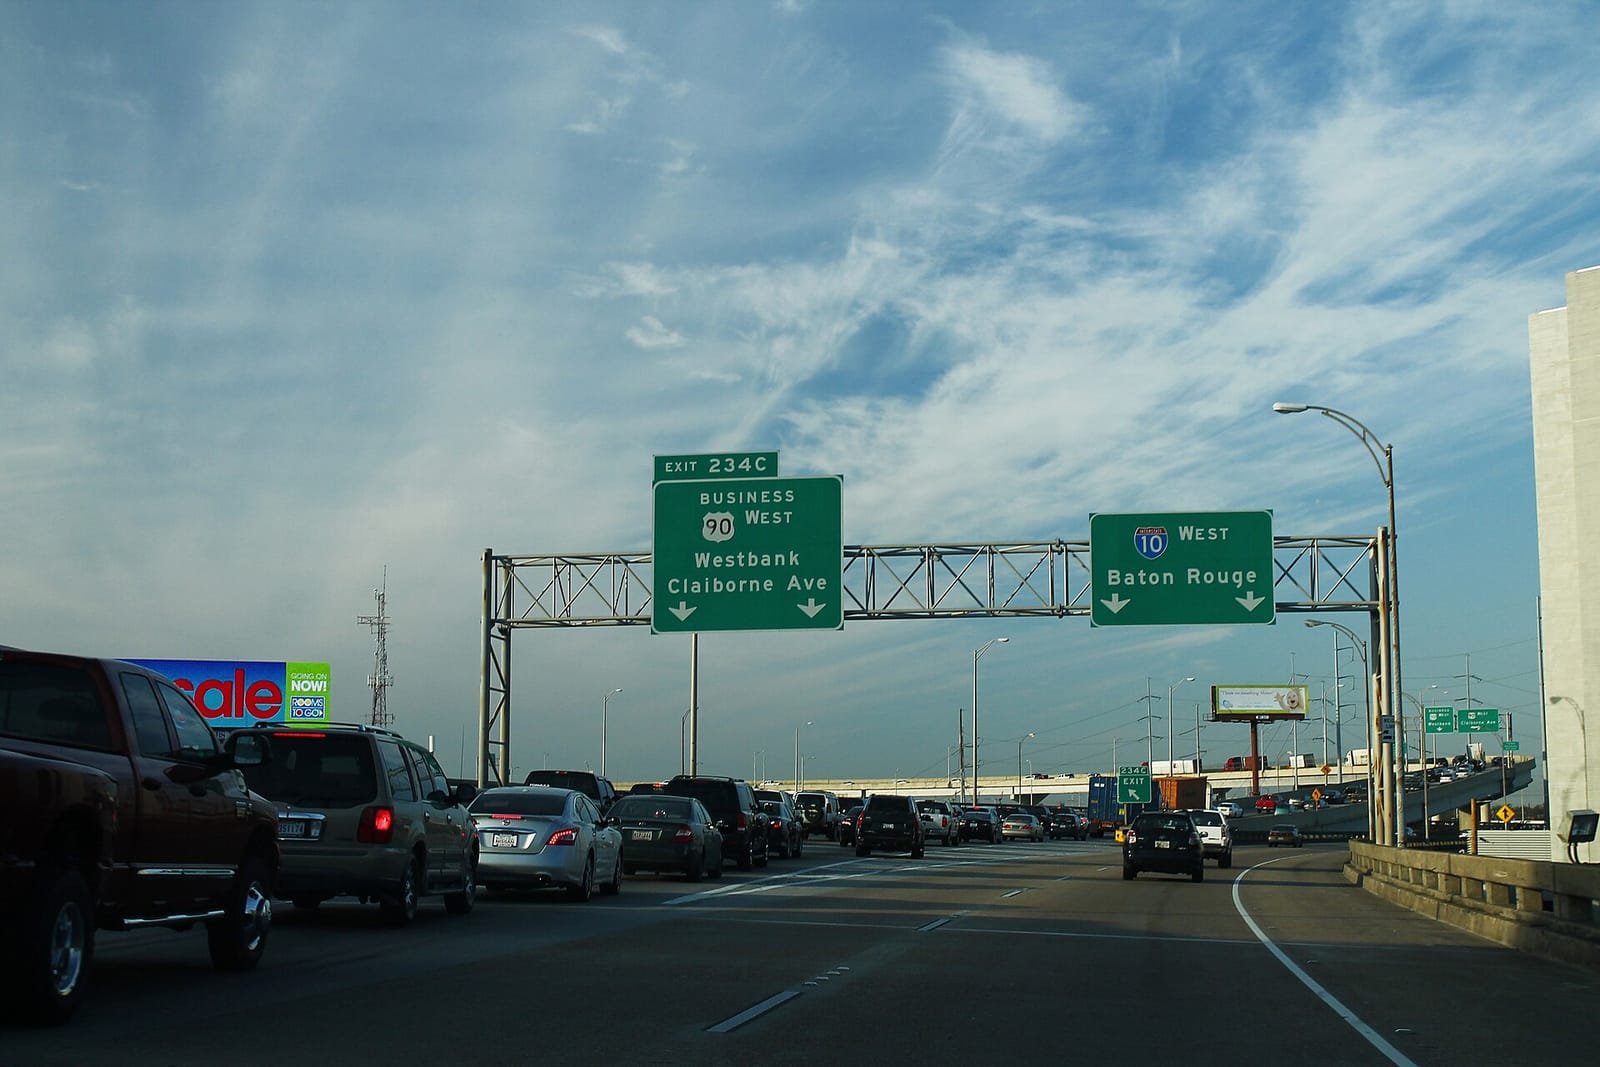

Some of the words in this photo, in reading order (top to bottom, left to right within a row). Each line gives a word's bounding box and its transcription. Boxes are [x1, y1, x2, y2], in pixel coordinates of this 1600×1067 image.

[665, 461, 698, 473] EXIT
[708, 456, 767, 473] 234C
[700, 489, 795, 505] BUSINESS
[705, 517, 732, 536] 90
[745, 510, 793, 525] WEST
[1140, 534, 1163, 553] 10
[1178, 525, 1229, 541] WEST
[694, 550, 800, 568] Westbank
[667, 576, 774, 594] Claiborne
[787, 575, 828, 591] Ave
[1107, 569, 1174, 586] Baton
[1187, 568, 1257, 588] Rouge
[291, 672, 314, 680] GOING
[291, 680, 327, 692] NOW!
[292, 698, 324, 707] ROOMS
[292, 708, 304, 717] TO
[304, 708, 319, 717] GO
[1123, 777, 1144, 785] EXIT
